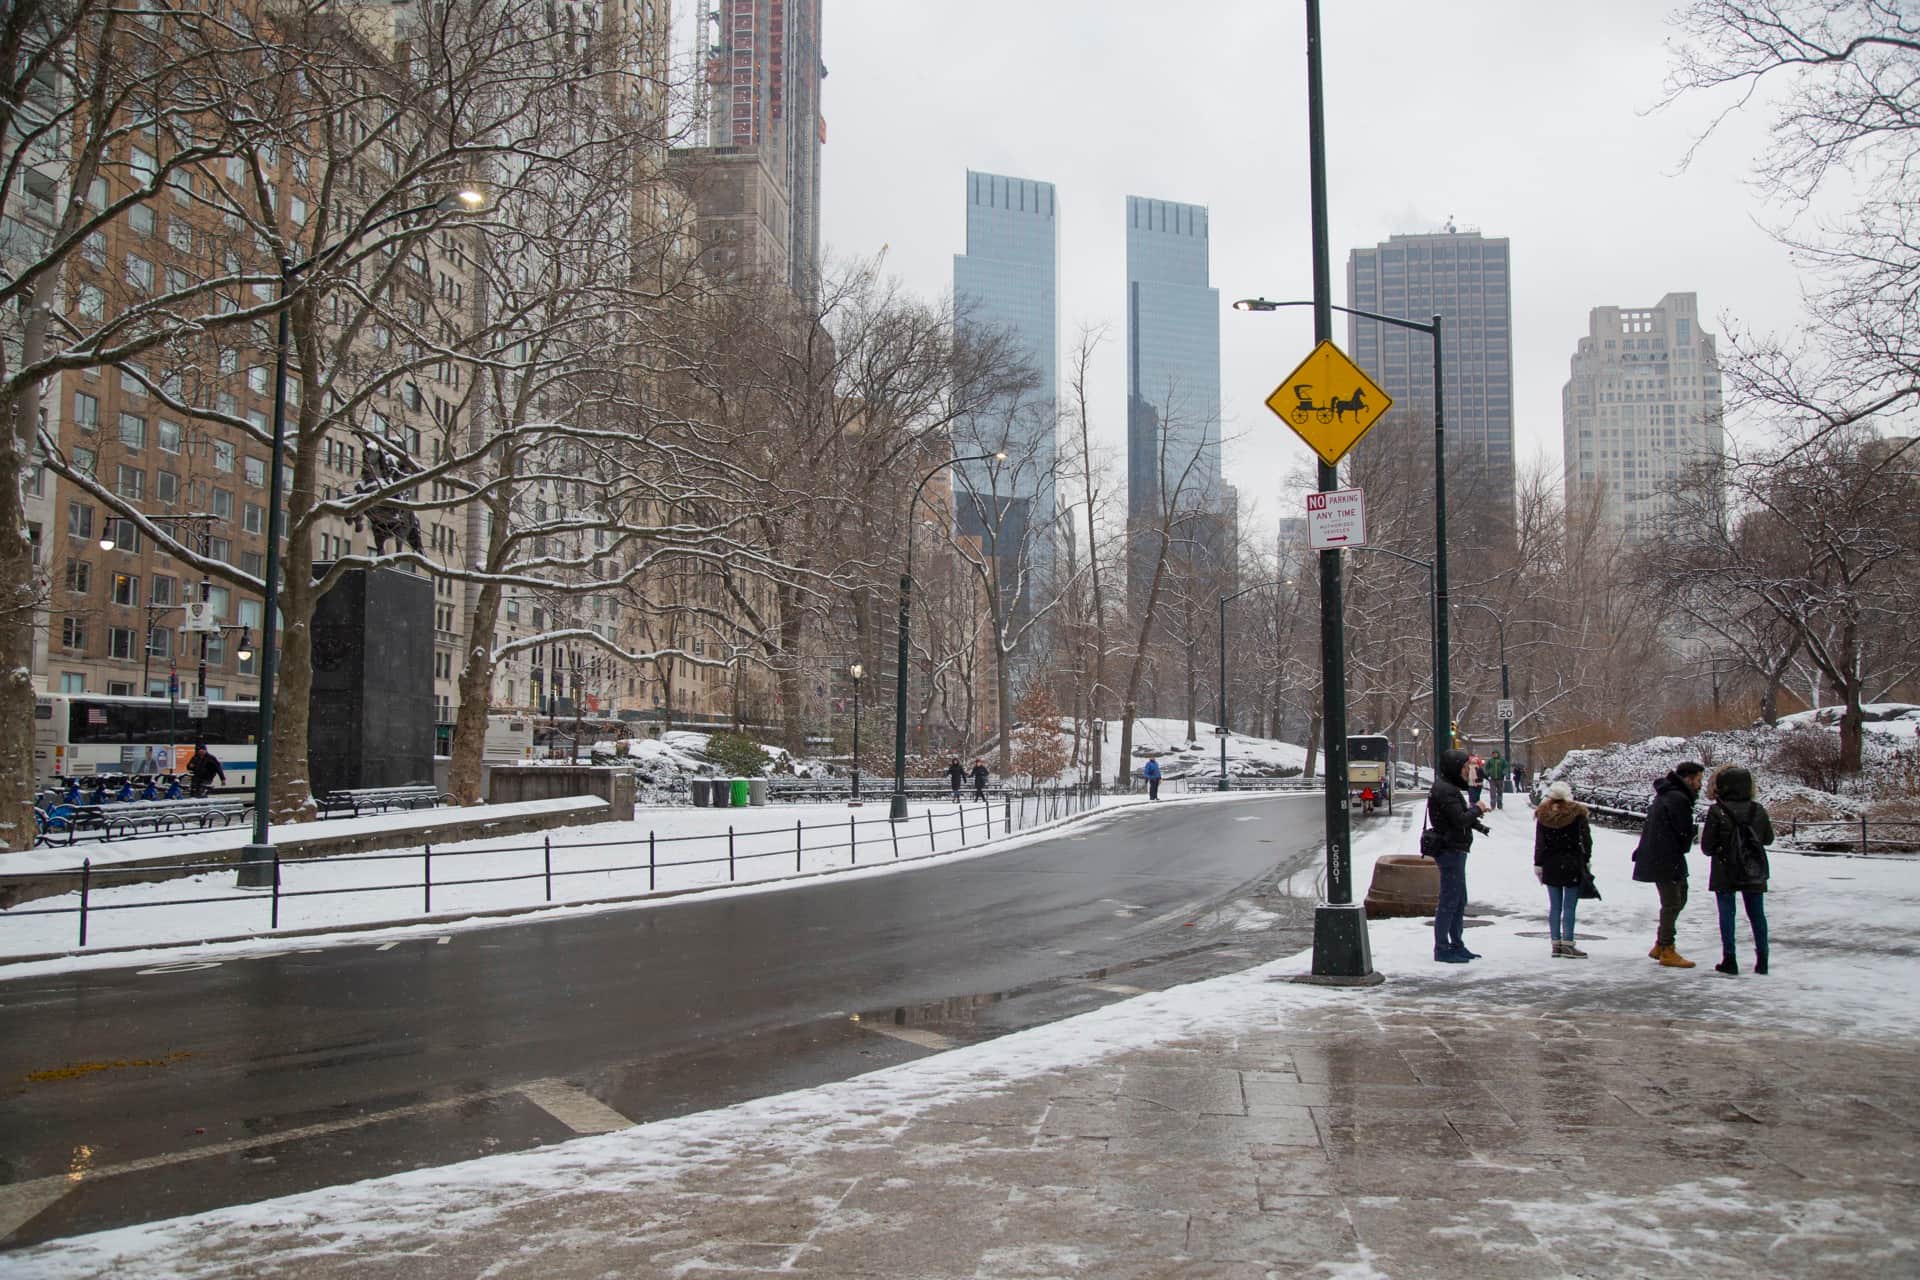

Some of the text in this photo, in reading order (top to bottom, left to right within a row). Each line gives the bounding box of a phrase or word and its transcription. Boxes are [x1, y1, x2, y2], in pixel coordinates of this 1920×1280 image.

[1309, 495, 1358, 509] NO PARKING
[1317, 509, 1356, 520] ANY TIME
[1499, 709, 1512, 718] 20
